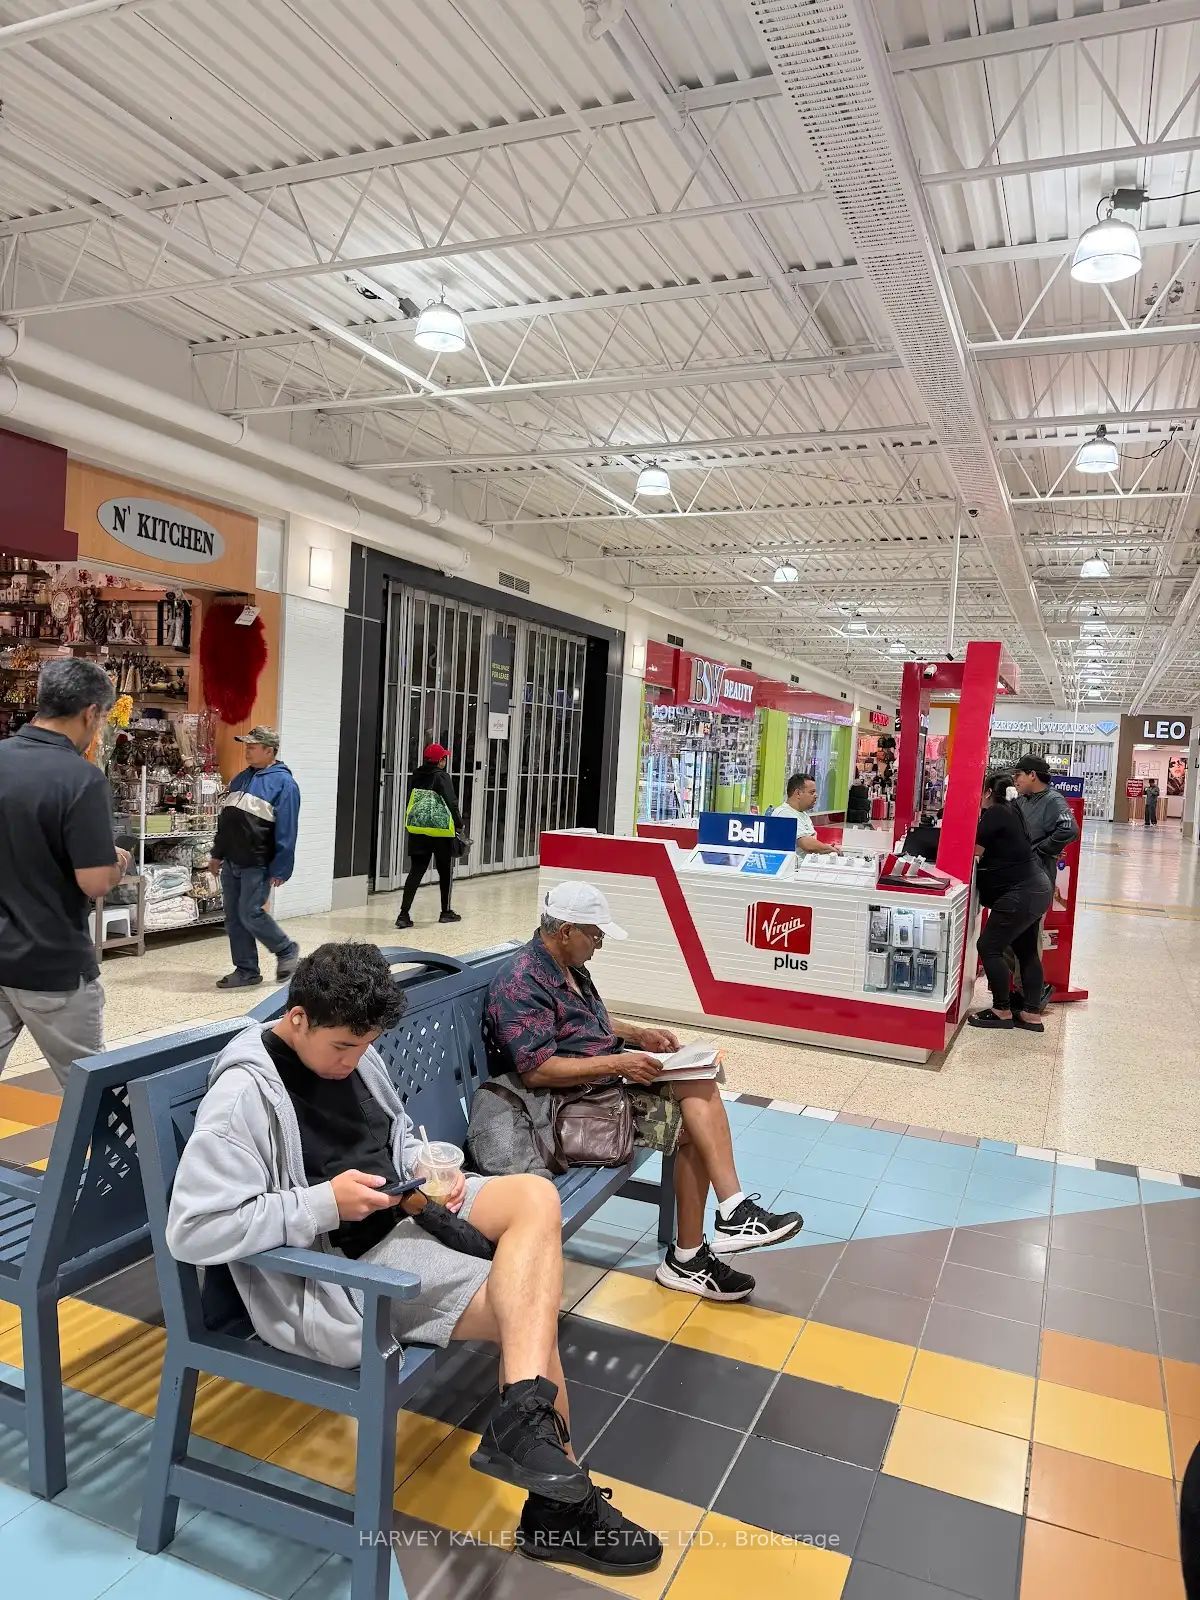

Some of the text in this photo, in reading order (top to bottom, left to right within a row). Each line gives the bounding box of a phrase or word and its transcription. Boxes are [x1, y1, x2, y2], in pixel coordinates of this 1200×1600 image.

[112, 505, 215, 556] N' KITCHEN
[498, 672, 509, 680] LEASE
[724, 679, 754, 703] BEAUTY
[1143, 720, 1186, 740] LEO
[1046, 755, 1062, 764] fido
[1055, 781, 1081, 792] offers!
[728, 819, 765, 844] Bell
[762, 907, 805, 948] Virgin
[774, 954, 808, 971] plus
